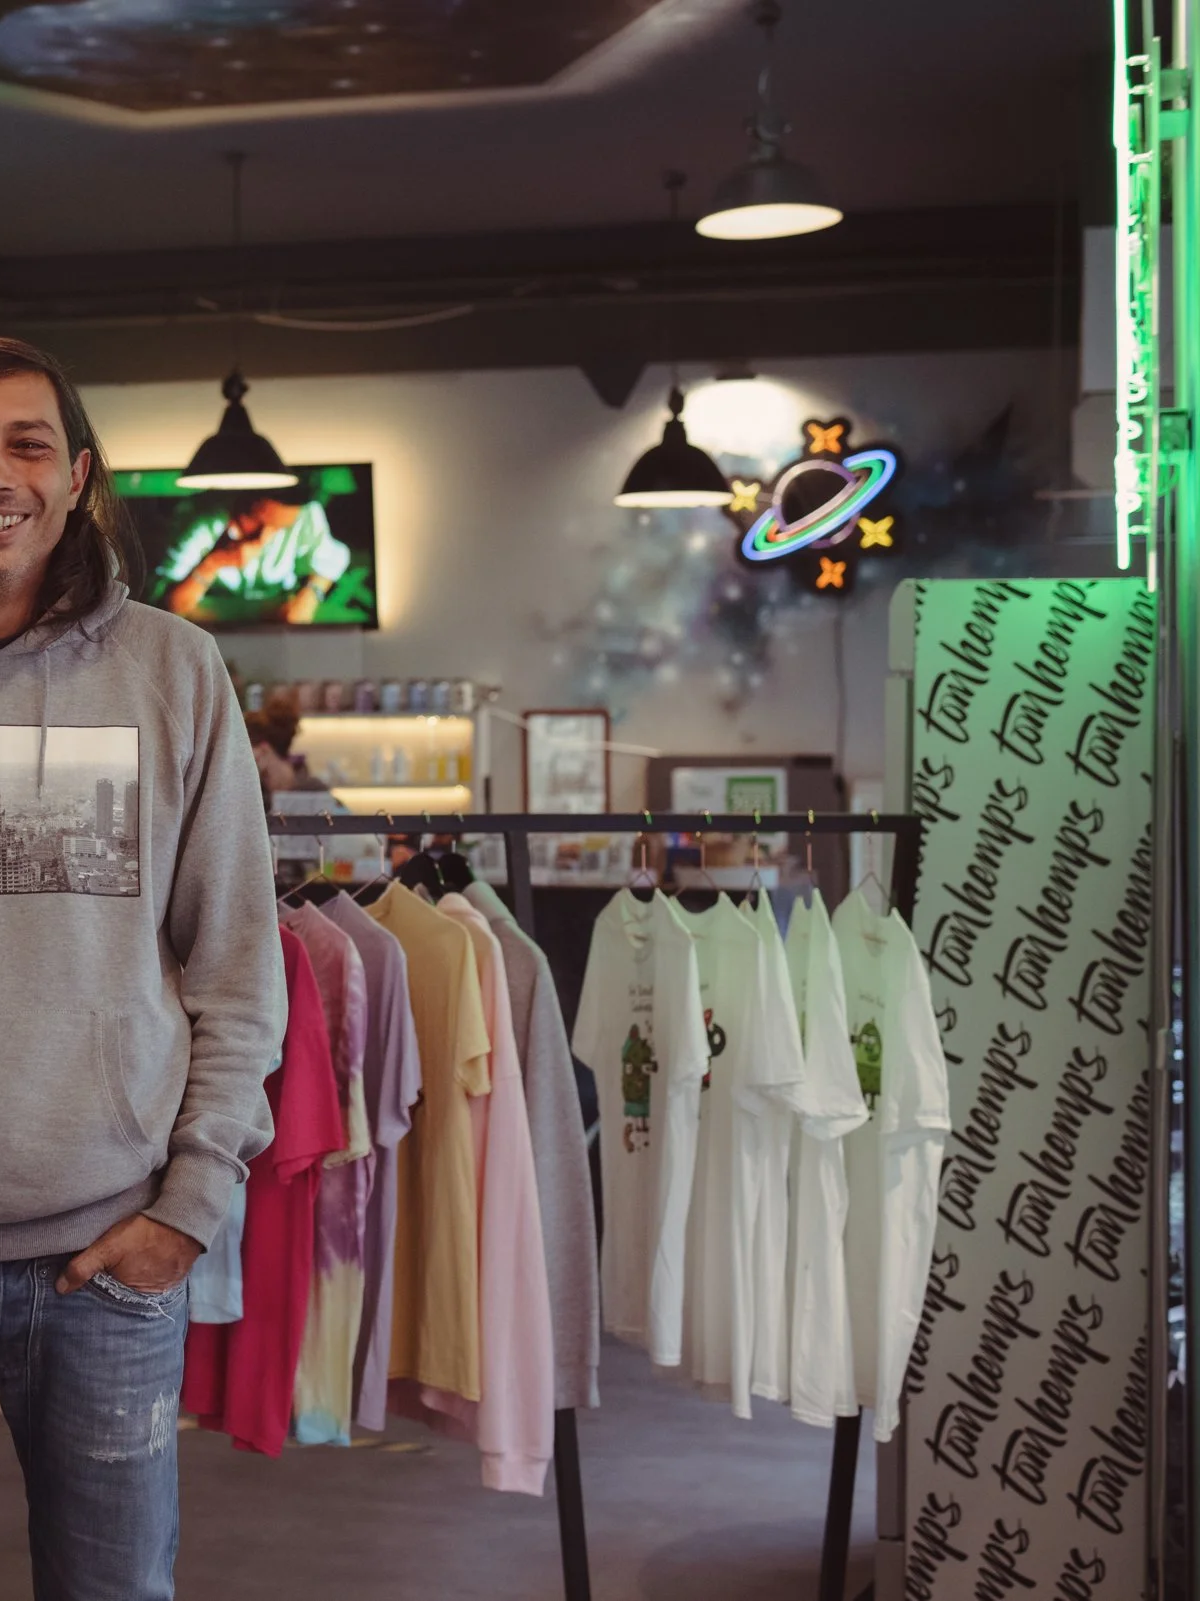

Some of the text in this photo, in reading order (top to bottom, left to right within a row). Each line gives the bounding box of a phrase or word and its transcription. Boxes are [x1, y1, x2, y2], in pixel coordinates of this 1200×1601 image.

[993, 799, 1111, 1011] tomhemp's
[924, 1269, 1042, 1480] tomhemp's
[996, 1046, 1114, 1257] tomhemp's
[991, 1293, 1111, 1506] tomhemp's
